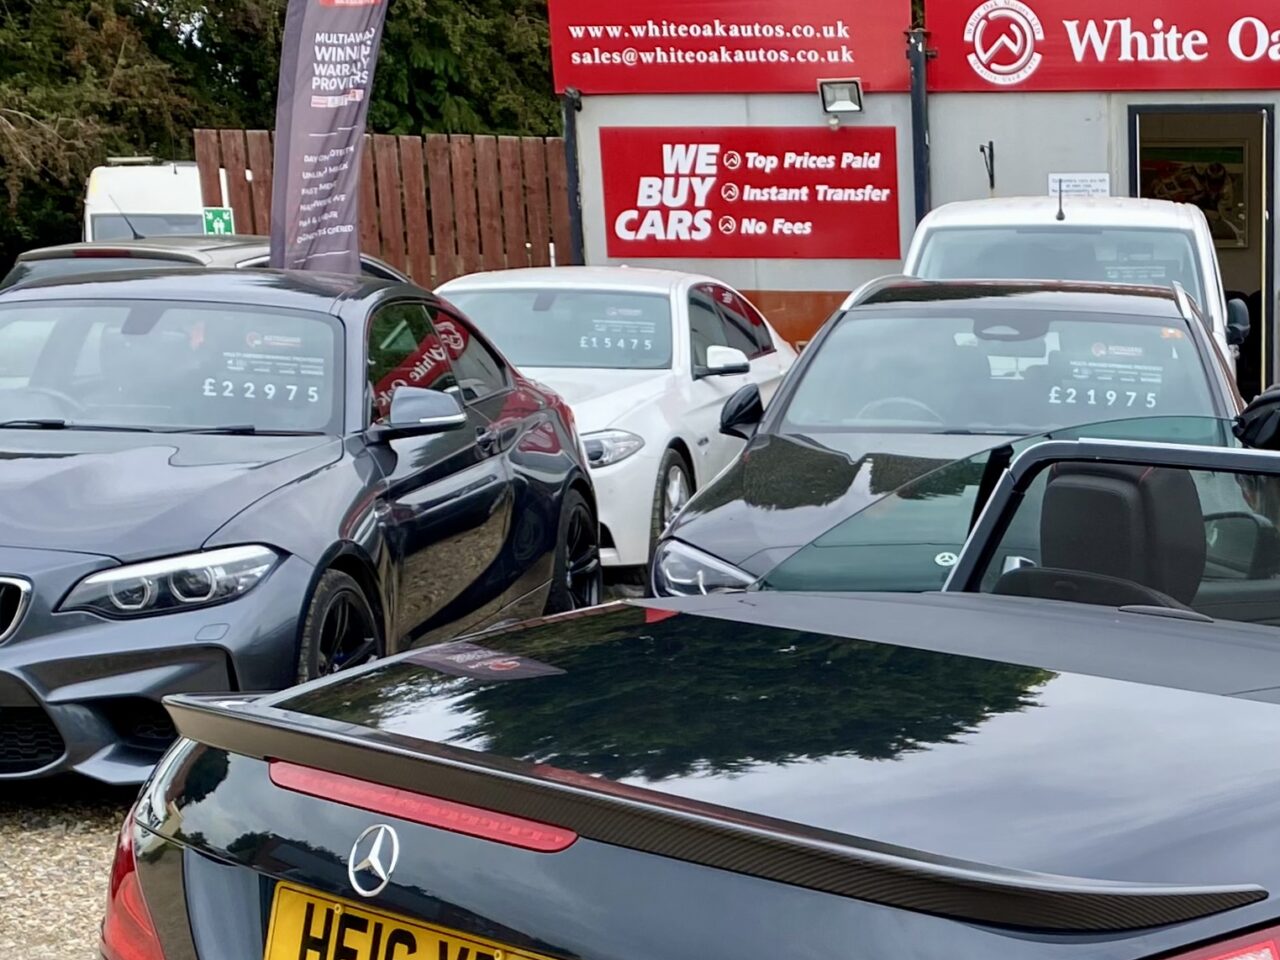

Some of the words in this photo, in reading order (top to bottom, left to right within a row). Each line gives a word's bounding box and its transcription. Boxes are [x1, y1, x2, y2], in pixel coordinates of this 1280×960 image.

[568, 20, 850, 39] www.whiteoakautos.co.uk
[1063, 17, 1208, 62] White
[571, 47, 854, 66] sales@whiteoakautos.co.uk
[662, 144, 720, 175] WE
[745, 152, 778, 173] Top
[783, 152, 835, 169] Prices
[841, 152, 880, 169] Paid
[637, 177, 716, 208] BUY
[742, 185, 808, 202] Instant
[815, 184, 890, 202] Transfer
[615, 210, 712, 241] CARS
[740, 219, 765, 235] No
[773, 218, 812, 235] Fees
[580, 336, 652, 351] £15475
[202, 378, 319, 402] £22975
[1049, 386, 1156, 408] £21975
